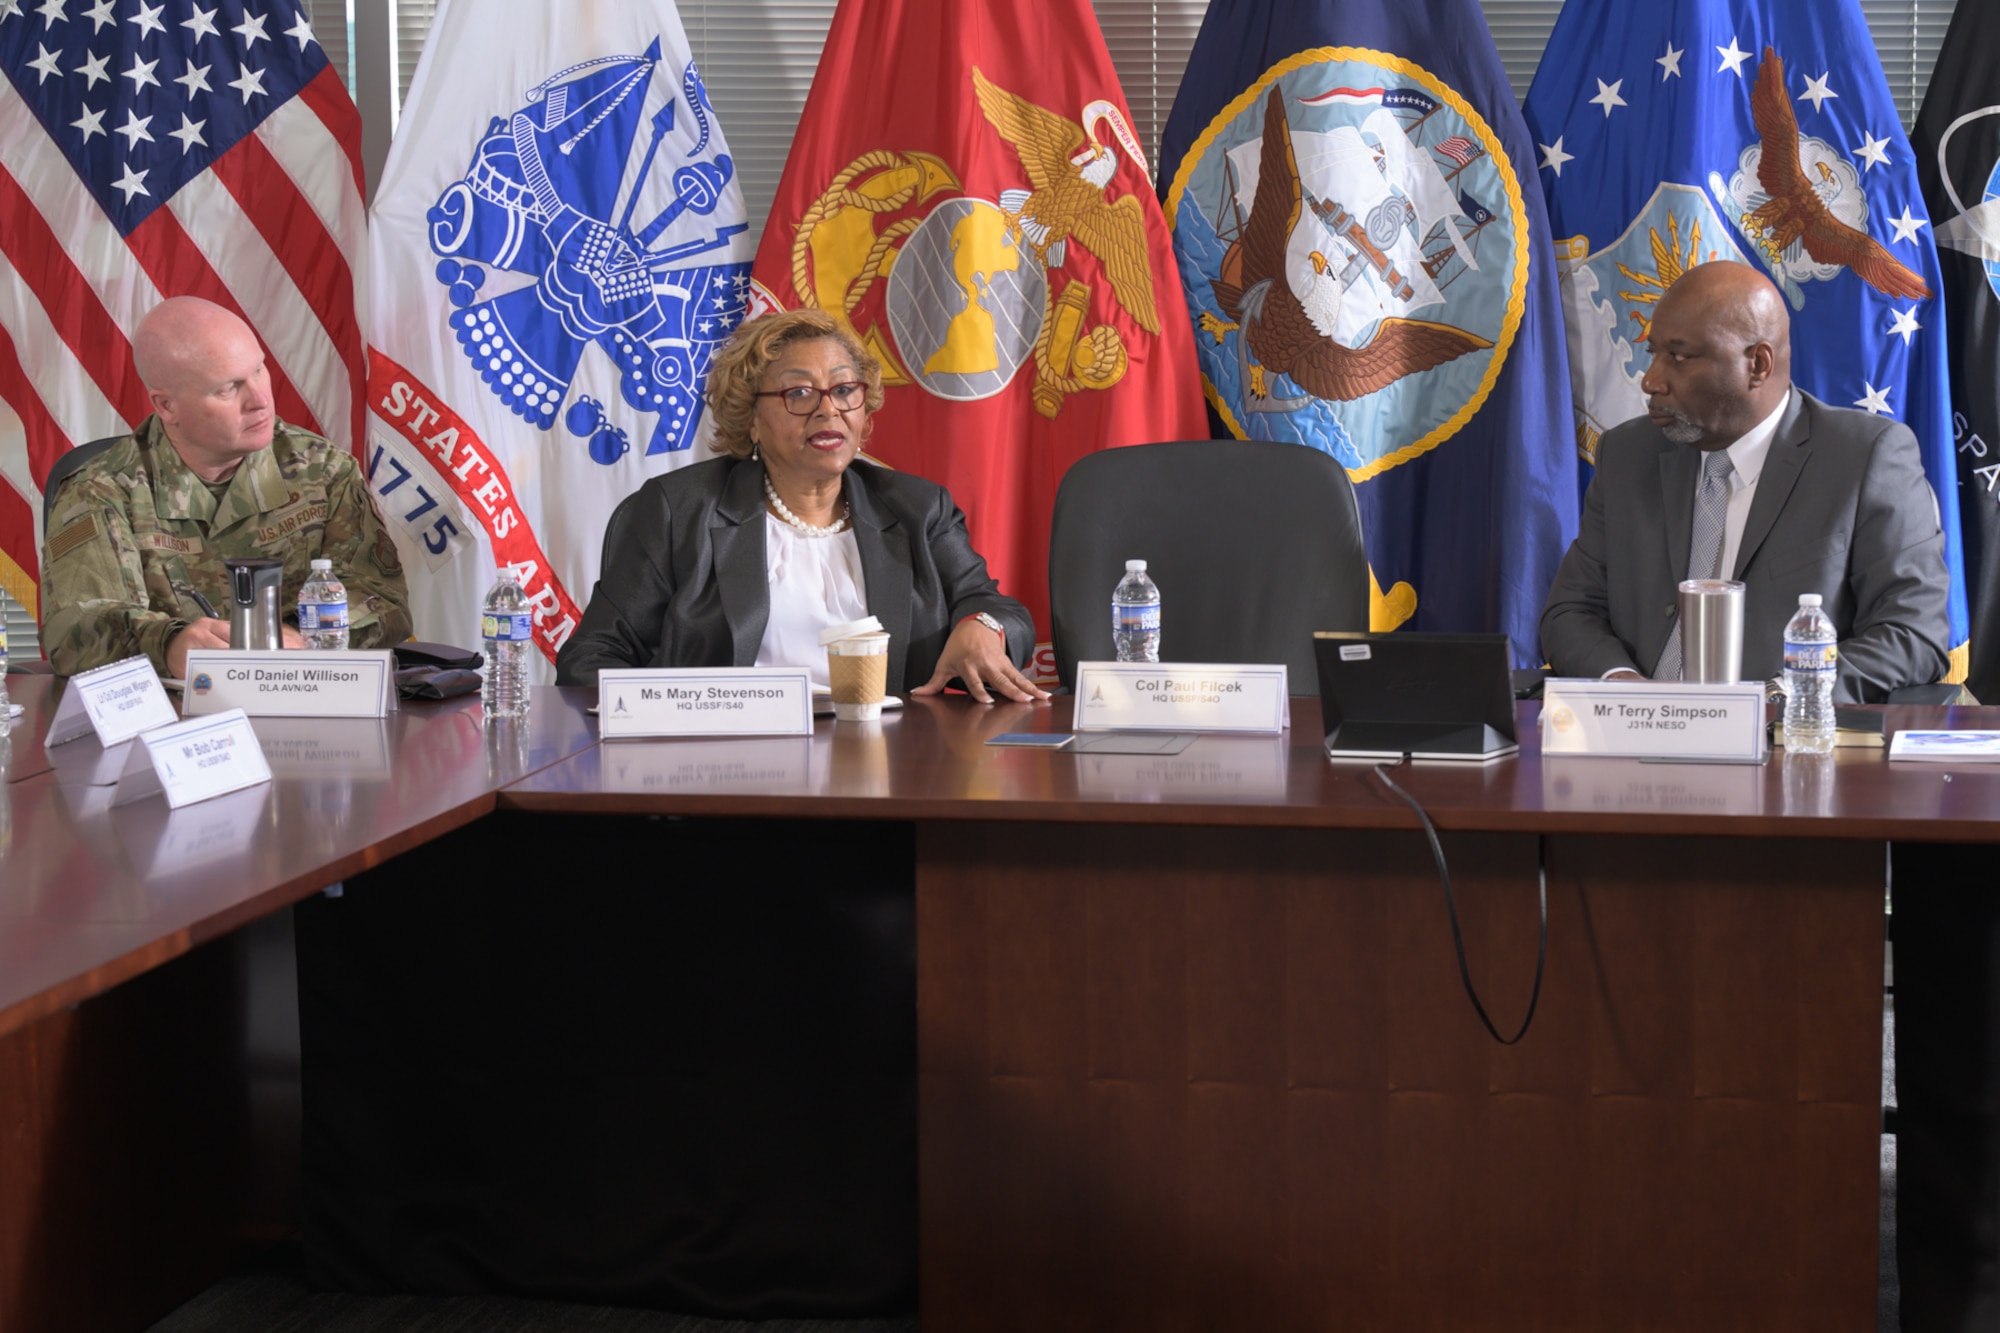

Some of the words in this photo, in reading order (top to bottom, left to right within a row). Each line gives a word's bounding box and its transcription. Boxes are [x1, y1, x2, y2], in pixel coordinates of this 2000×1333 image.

[1108, 110, 1131, 145] SEMPER
[381, 381, 518, 539] STATES
[1953, 411, 2000, 504] SPA
[369, 444, 458, 555] 1775
[257, 527, 278, 542] U.S.
[278, 517, 297, 536] AIR
[296, 505, 327, 525] FORCE
[1798, 660, 1828, 669] PARK
[226, 668, 250, 681] Col
[254, 669, 299, 681] Daniel
[302, 669, 359, 682] Willison
[259, 683, 279, 692] DLA
[280, 683, 319, 692] AVN/QA
[1135, 679, 1159, 692] Col
[1164, 680, 1196, 692] Paul
[1201, 680, 1243, 693] Filcek
[641, 688, 662, 700] Ms
[667, 687, 702, 701] Mary
[707, 687, 784, 699] Stevenson
[1152, 694, 1168, 703] HQ
[677, 701, 693, 711] HQ
[1594, 704, 1613, 717] Mr
[1617, 704, 1656, 720] Terry
[1660, 704, 1728, 720] Simpson
[1627, 720, 1653, 730] J31N
[1655, 720, 1687, 730] NESO
[182, 745, 194, 759] Mr
[193, 740, 211, 756] Bob
[210, 733, 237, 751] Carroll
